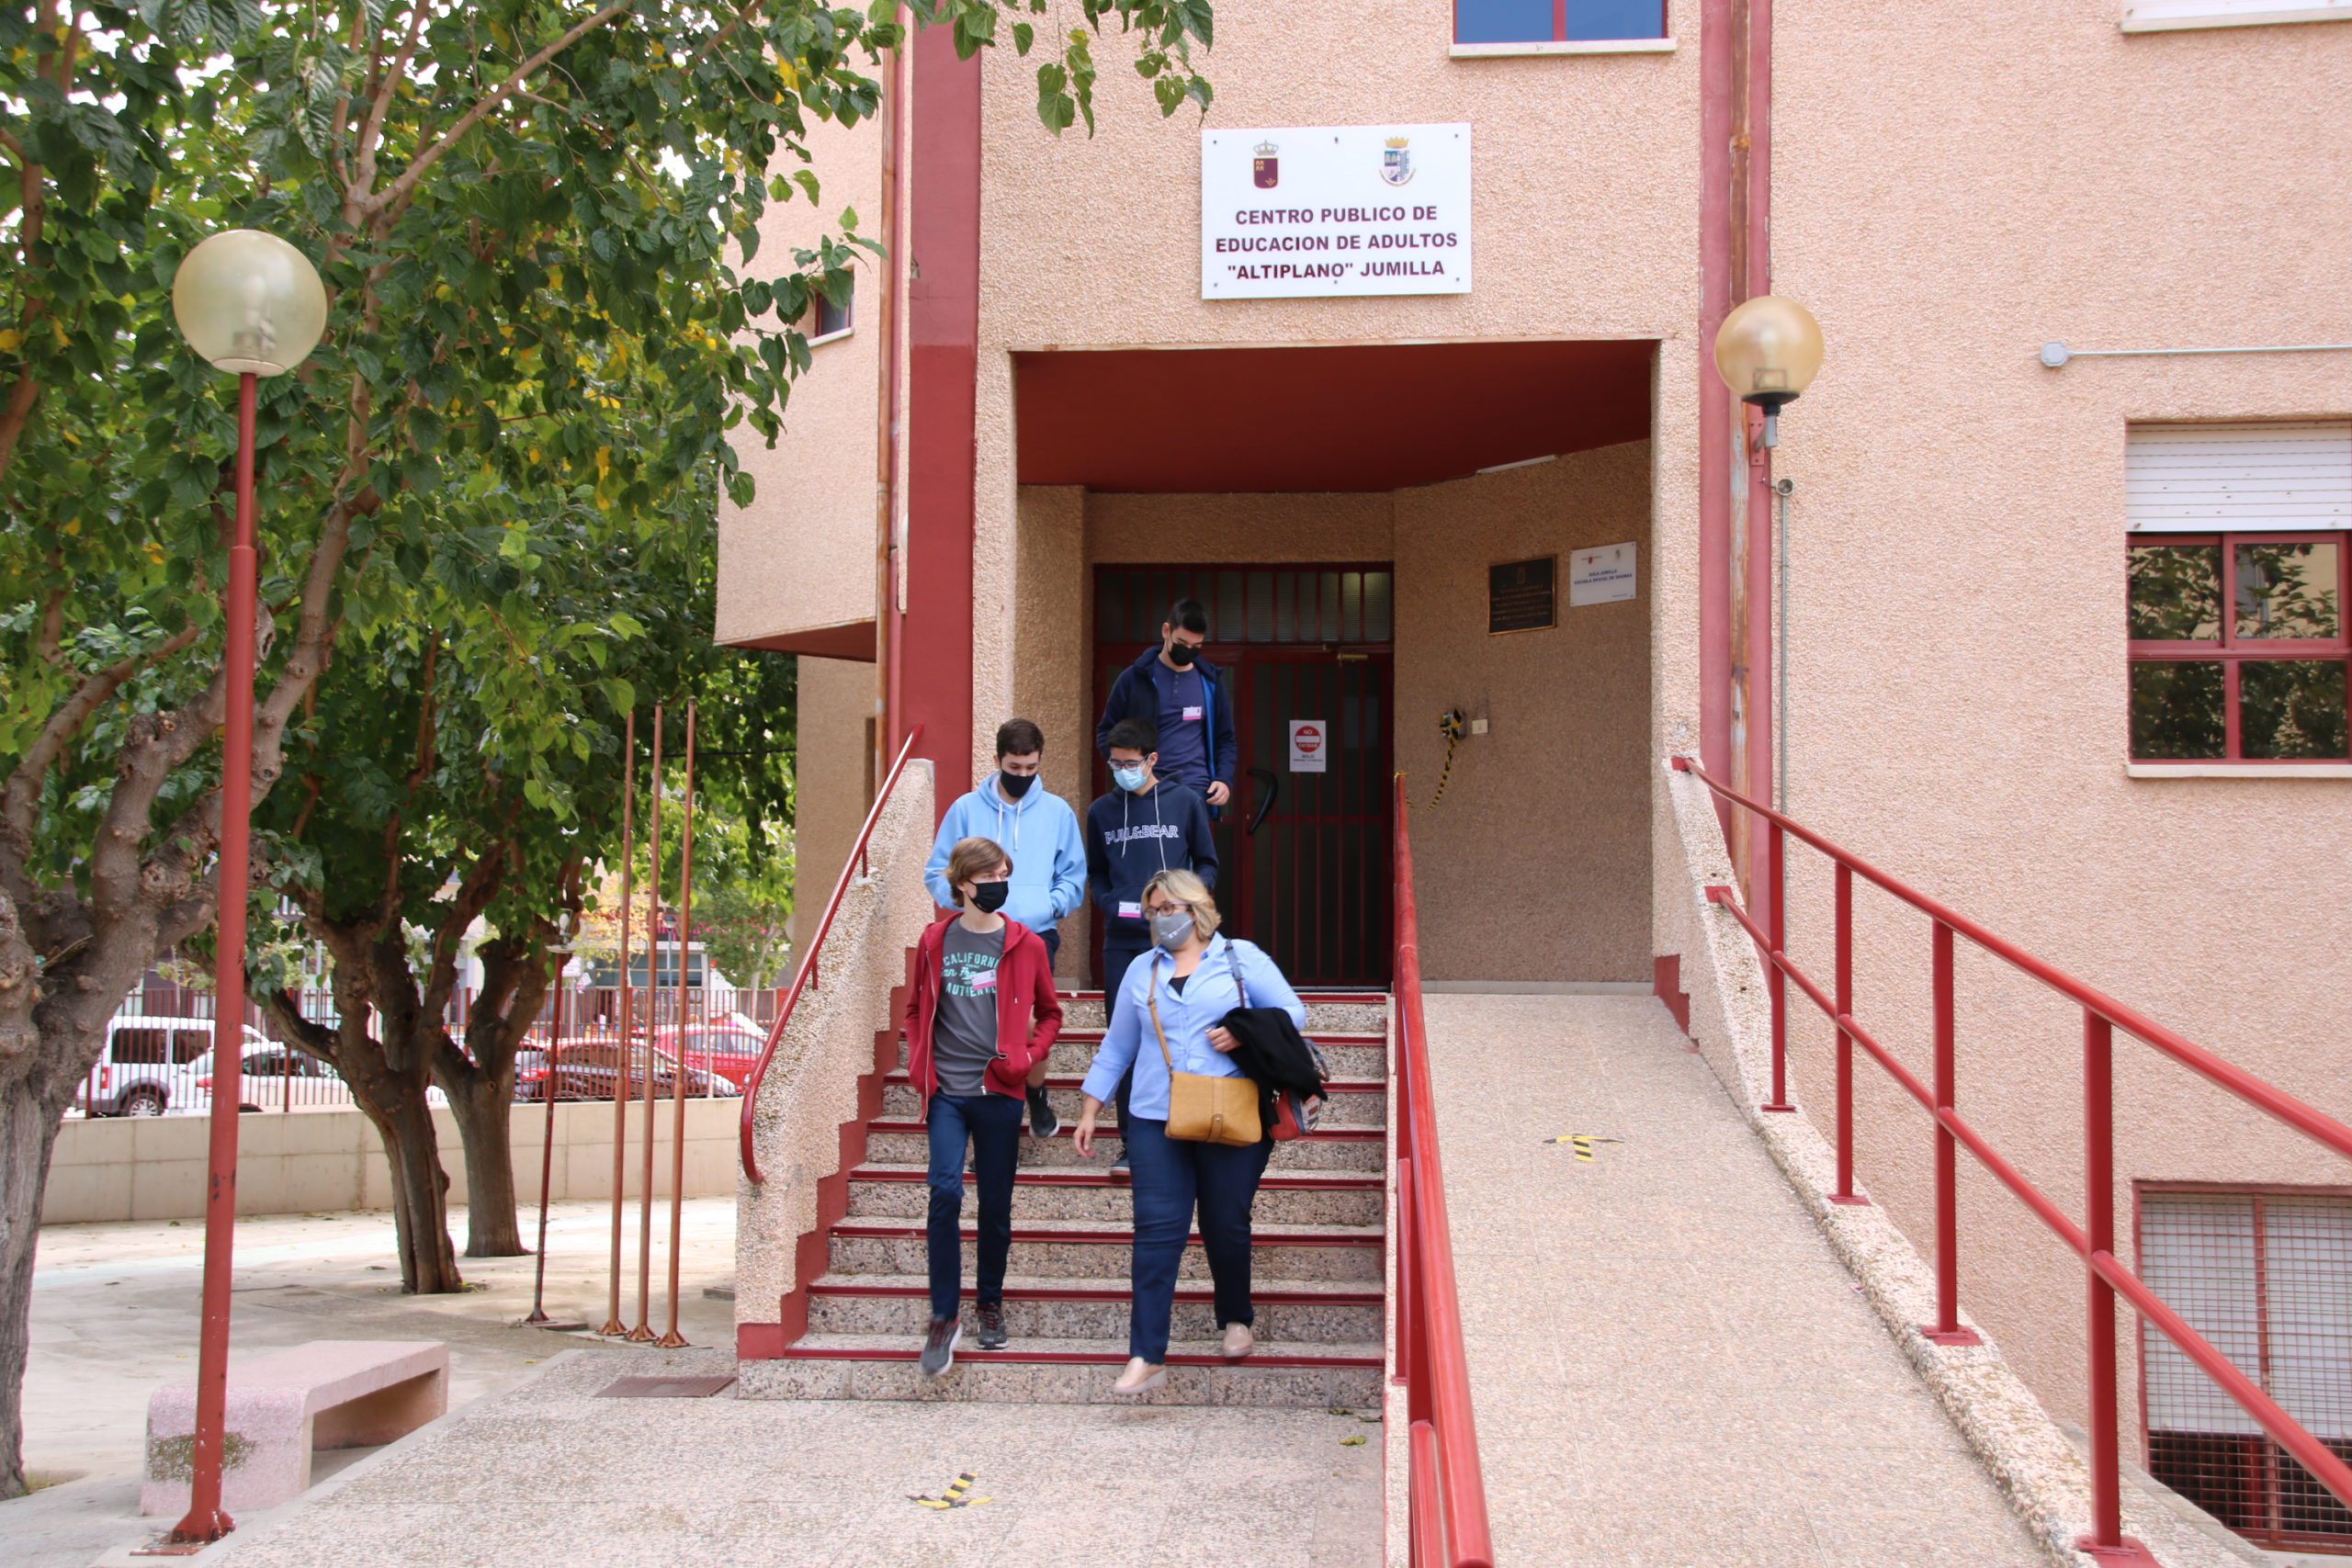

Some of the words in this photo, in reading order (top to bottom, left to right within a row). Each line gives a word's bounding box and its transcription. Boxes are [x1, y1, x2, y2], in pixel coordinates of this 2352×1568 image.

[1235, 209, 1314, 225] CENTRO
[1320, 207, 1406, 223] PUBLICO
[1412, 206, 1438, 221] DE
[1216, 235, 1329, 254] EDUCACION
[1336, 234, 1362, 250] DE
[1367, 232, 1458, 250] ADULTOS
[1227, 263, 1353, 280] "ALTIPLANO"
[1360, 260, 1445, 277] JUMILLA
[1104, 824, 1179, 844] PULL&BEAR
[943, 952, 1000, 969] CALIFORNI
